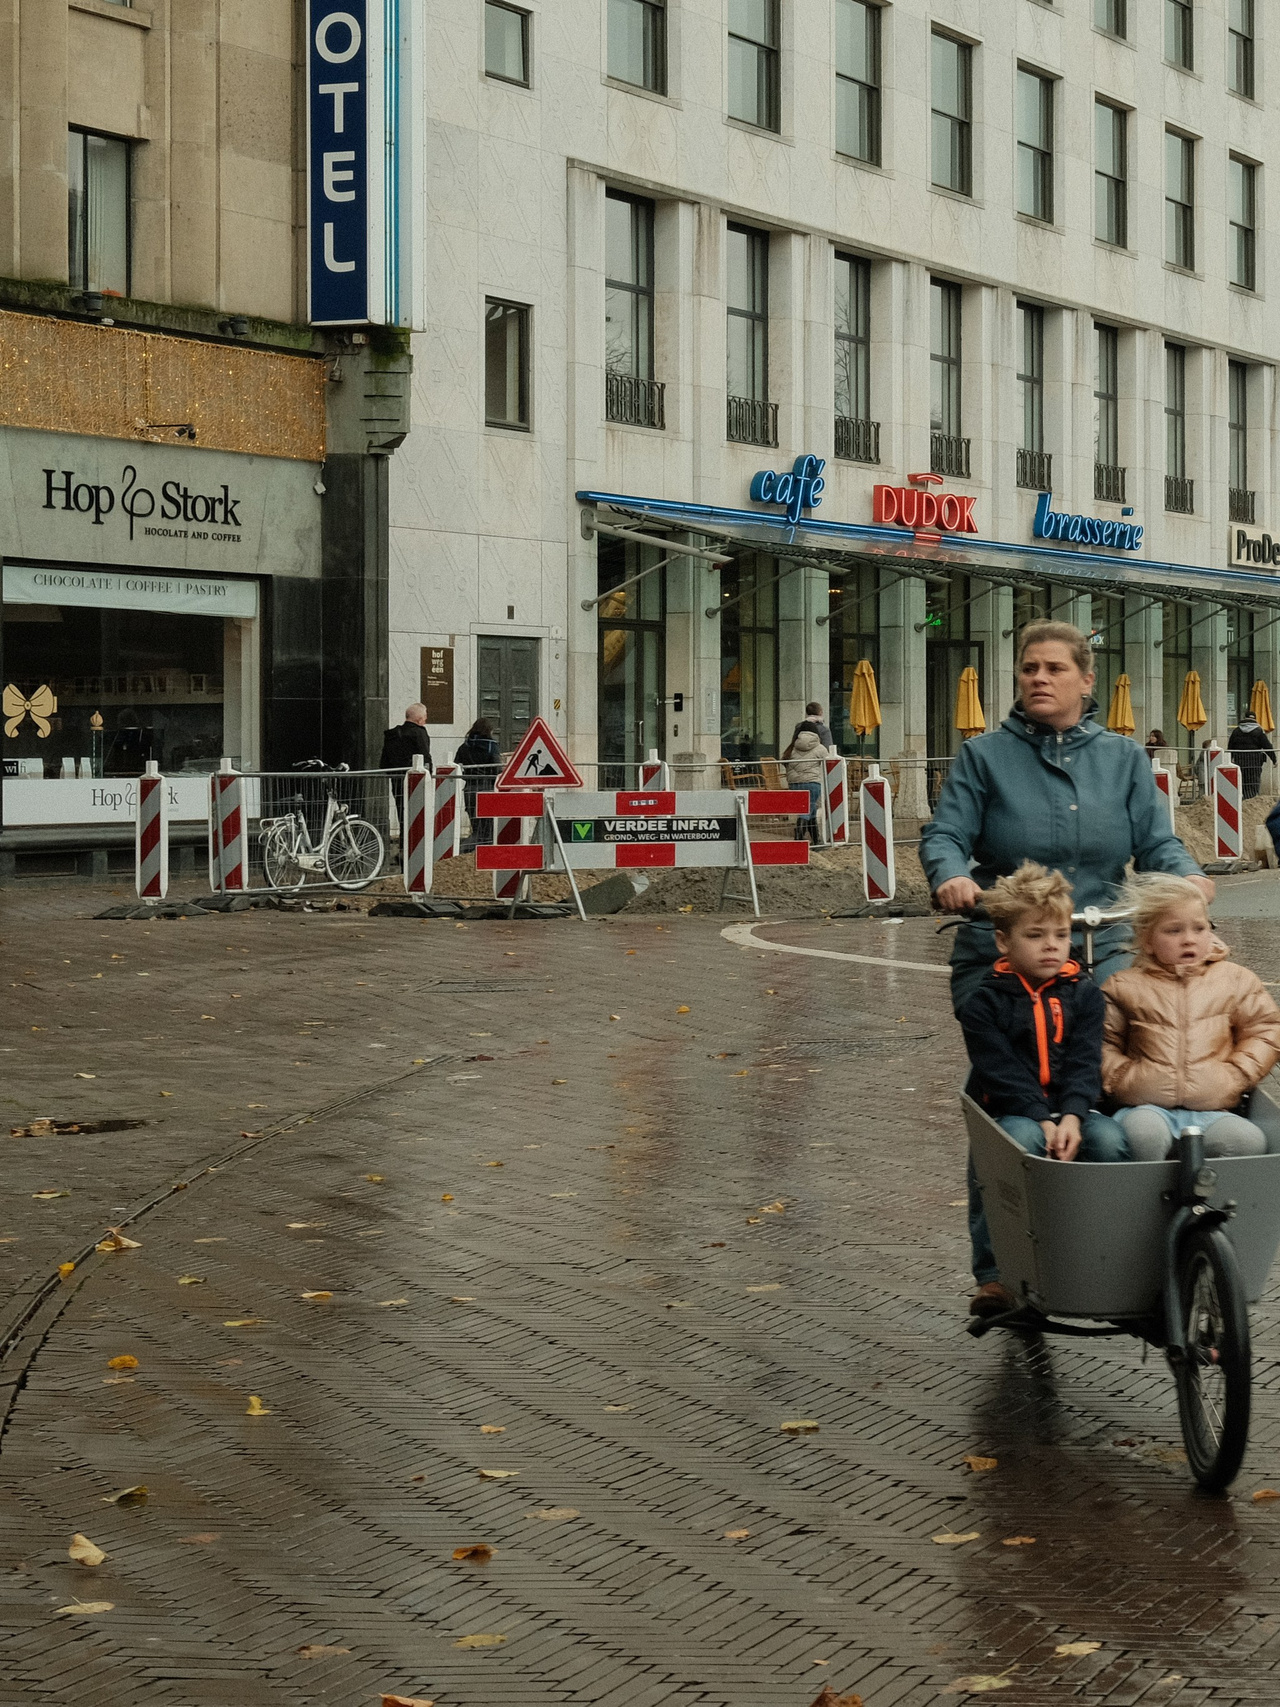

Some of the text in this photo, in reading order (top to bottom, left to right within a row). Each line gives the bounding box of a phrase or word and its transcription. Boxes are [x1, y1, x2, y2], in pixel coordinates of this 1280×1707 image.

[315, 11, 362, 273] OTEL
[42, 468, 242, 526] Hop Stork
[750, 454, 825, 523] café
[873, 484, 978, 533] DUDOK
[1033, 492, 1144, 550] brasserie
[144, 527, 242, 542] HOCOLATE AND COFFEE
[33, 573, 229, 596] CHOCOLATE COFFEE PASTRY
[432, 649, 444, 658] hof
[91, 788, 123, 811] Hop
[604, 820, 668, 832] VERDEE
[672, 819, 720, 831] INFRA
[604, 833, 638, 841] GROND-,
[638, 833, 659, 841] WEG-
[671, 832, 720, 840] WATERBOUW
